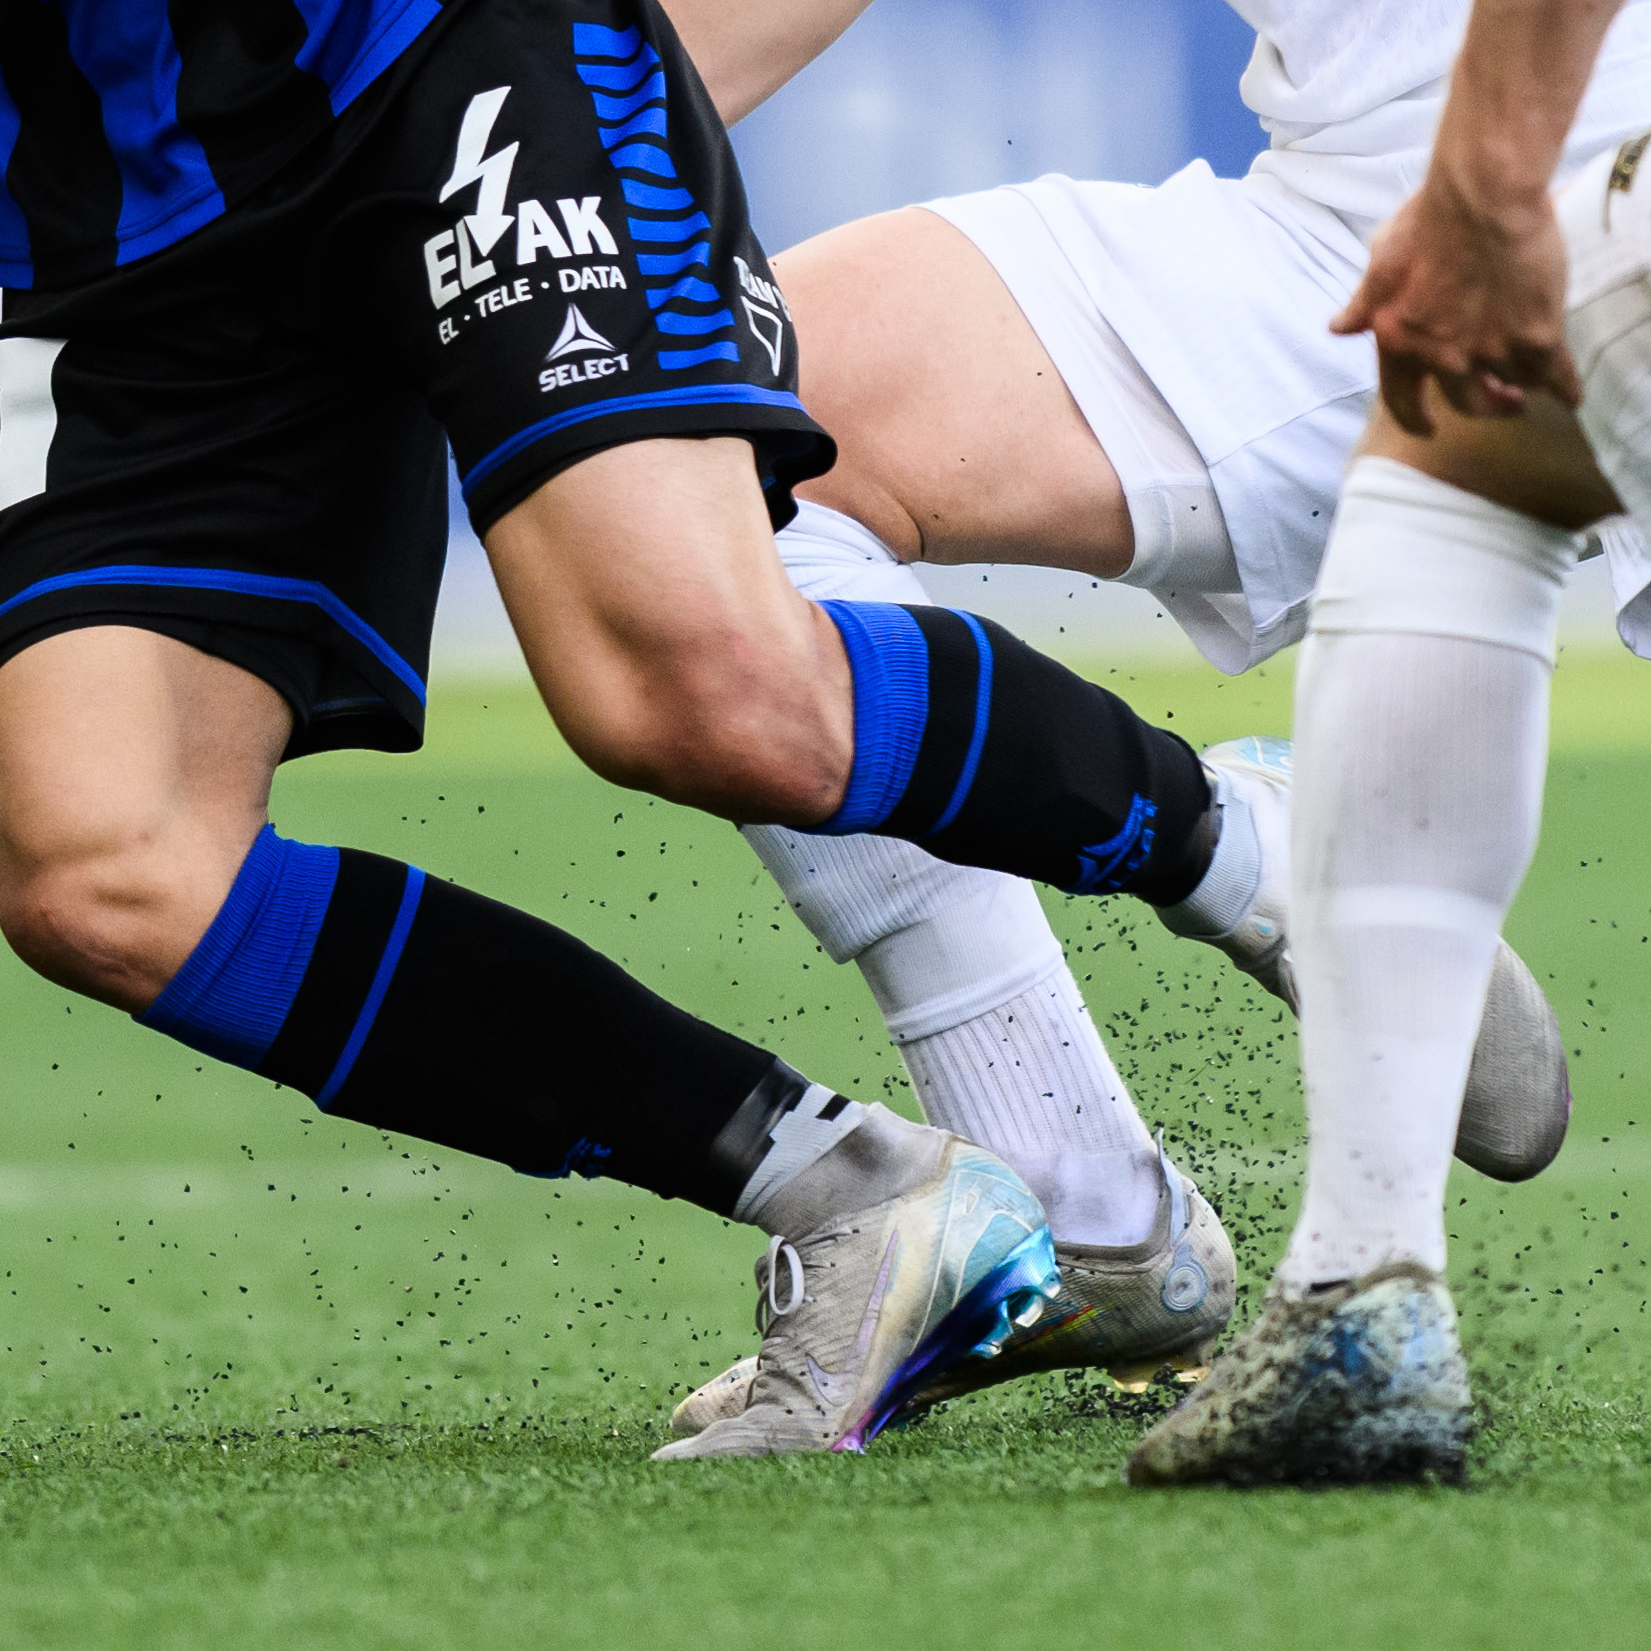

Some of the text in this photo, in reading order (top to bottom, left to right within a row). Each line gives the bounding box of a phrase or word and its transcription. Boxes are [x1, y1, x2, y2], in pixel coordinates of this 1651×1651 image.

[438, 265, 628, 345] EL TELE DATA
[538, 353, 630, 393] SELECT
